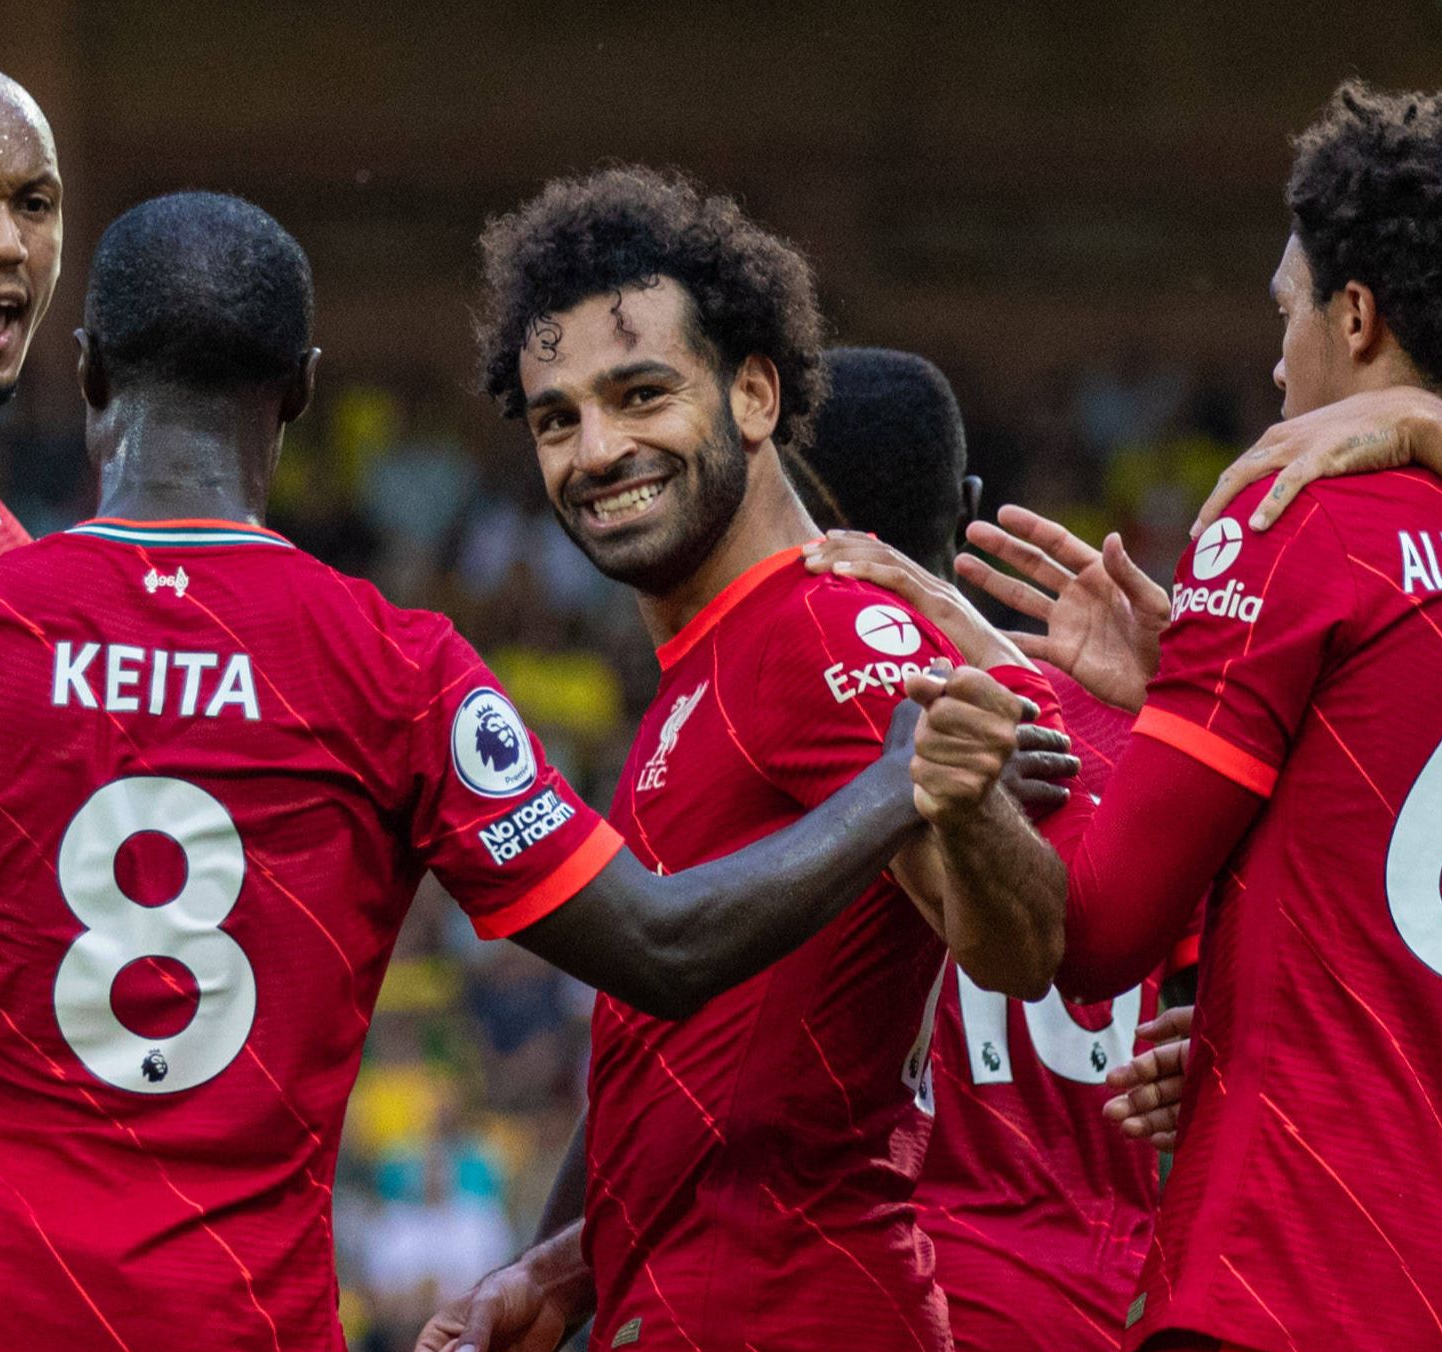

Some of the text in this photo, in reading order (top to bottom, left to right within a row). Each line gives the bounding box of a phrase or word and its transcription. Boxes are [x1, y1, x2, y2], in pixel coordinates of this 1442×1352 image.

[52, 641, 261, 720] KEITA
[636, 766, 668, 792] LFC
[478, 819, 515, 848] No
[489, 836, 524, 867] for
[53, 775, 258, 1094] 8
